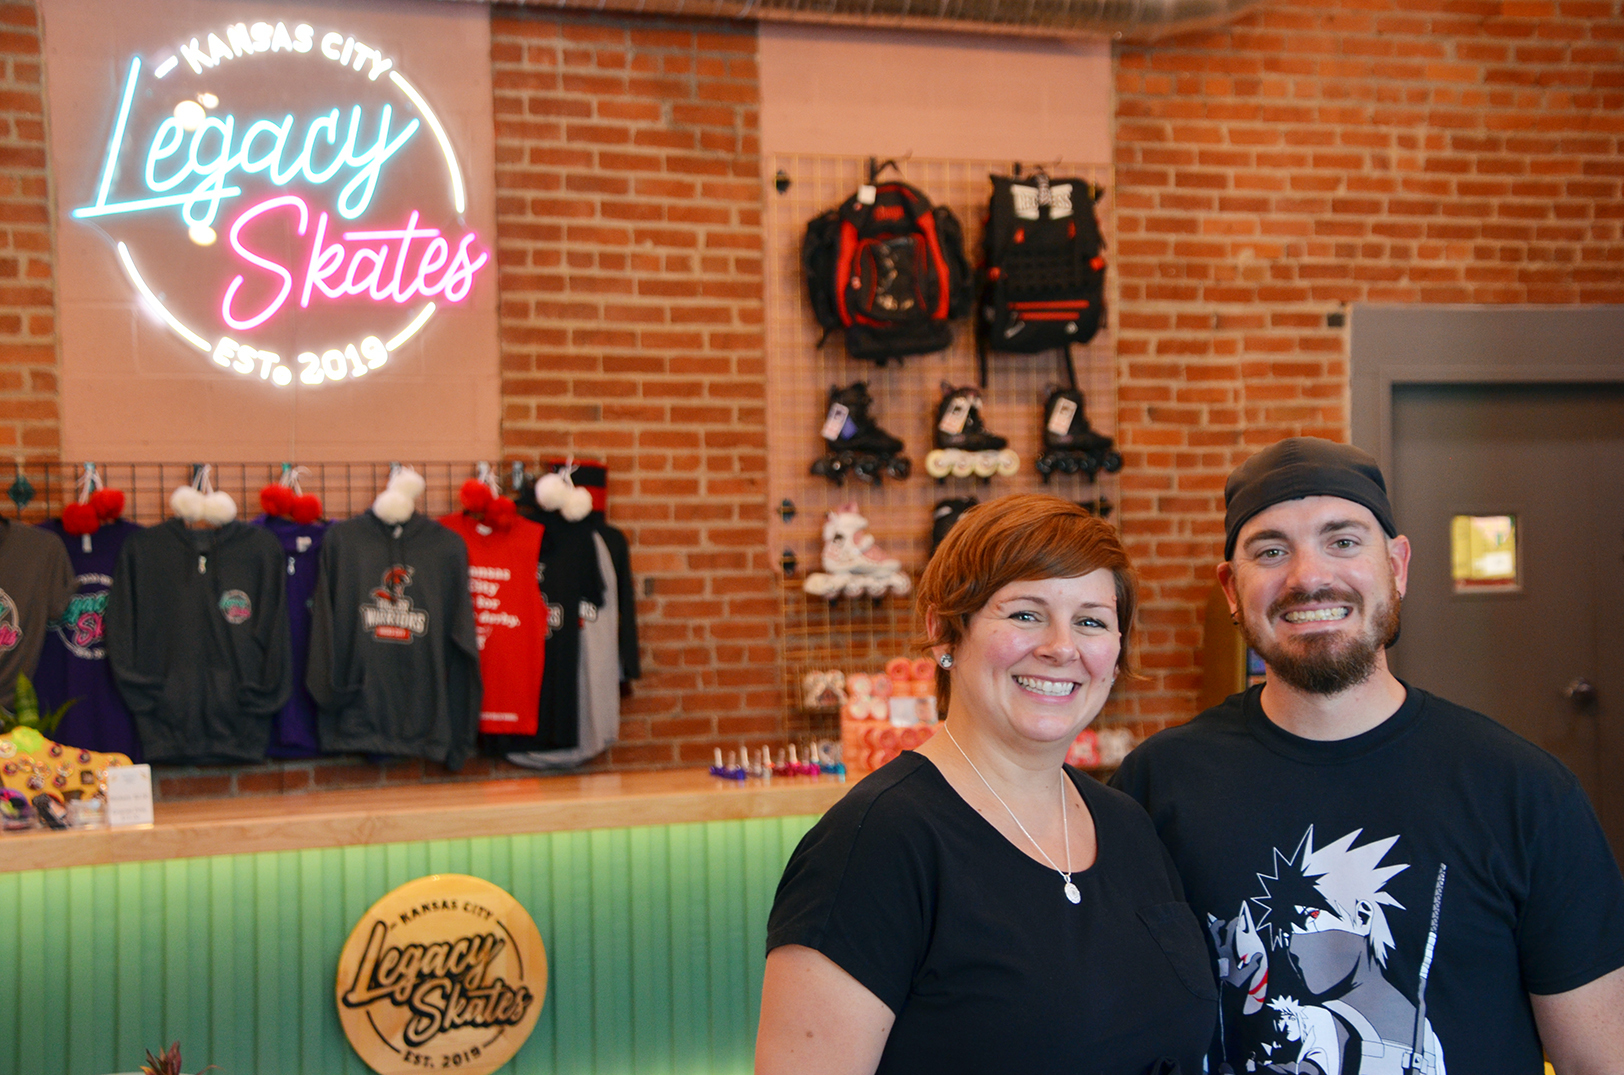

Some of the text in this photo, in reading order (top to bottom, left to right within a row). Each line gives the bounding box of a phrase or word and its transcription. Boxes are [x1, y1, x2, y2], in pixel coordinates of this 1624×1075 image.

[180, 21, 393, 82] KANSAS CITY
[71, 56, 420, 228] Legacy
[221, 195, 489, 331] Skates
[212, 335, 389, 386] EST. 2019
[364, 606, 426, 633] WARRIORS
[399, 900, 494, 925] KANSAS CITY
[342, 920, 506, 1008] Legacy
[403, 977, 533, 1047] Skates
[403, 1047, 481, 1068] EST. 2019
